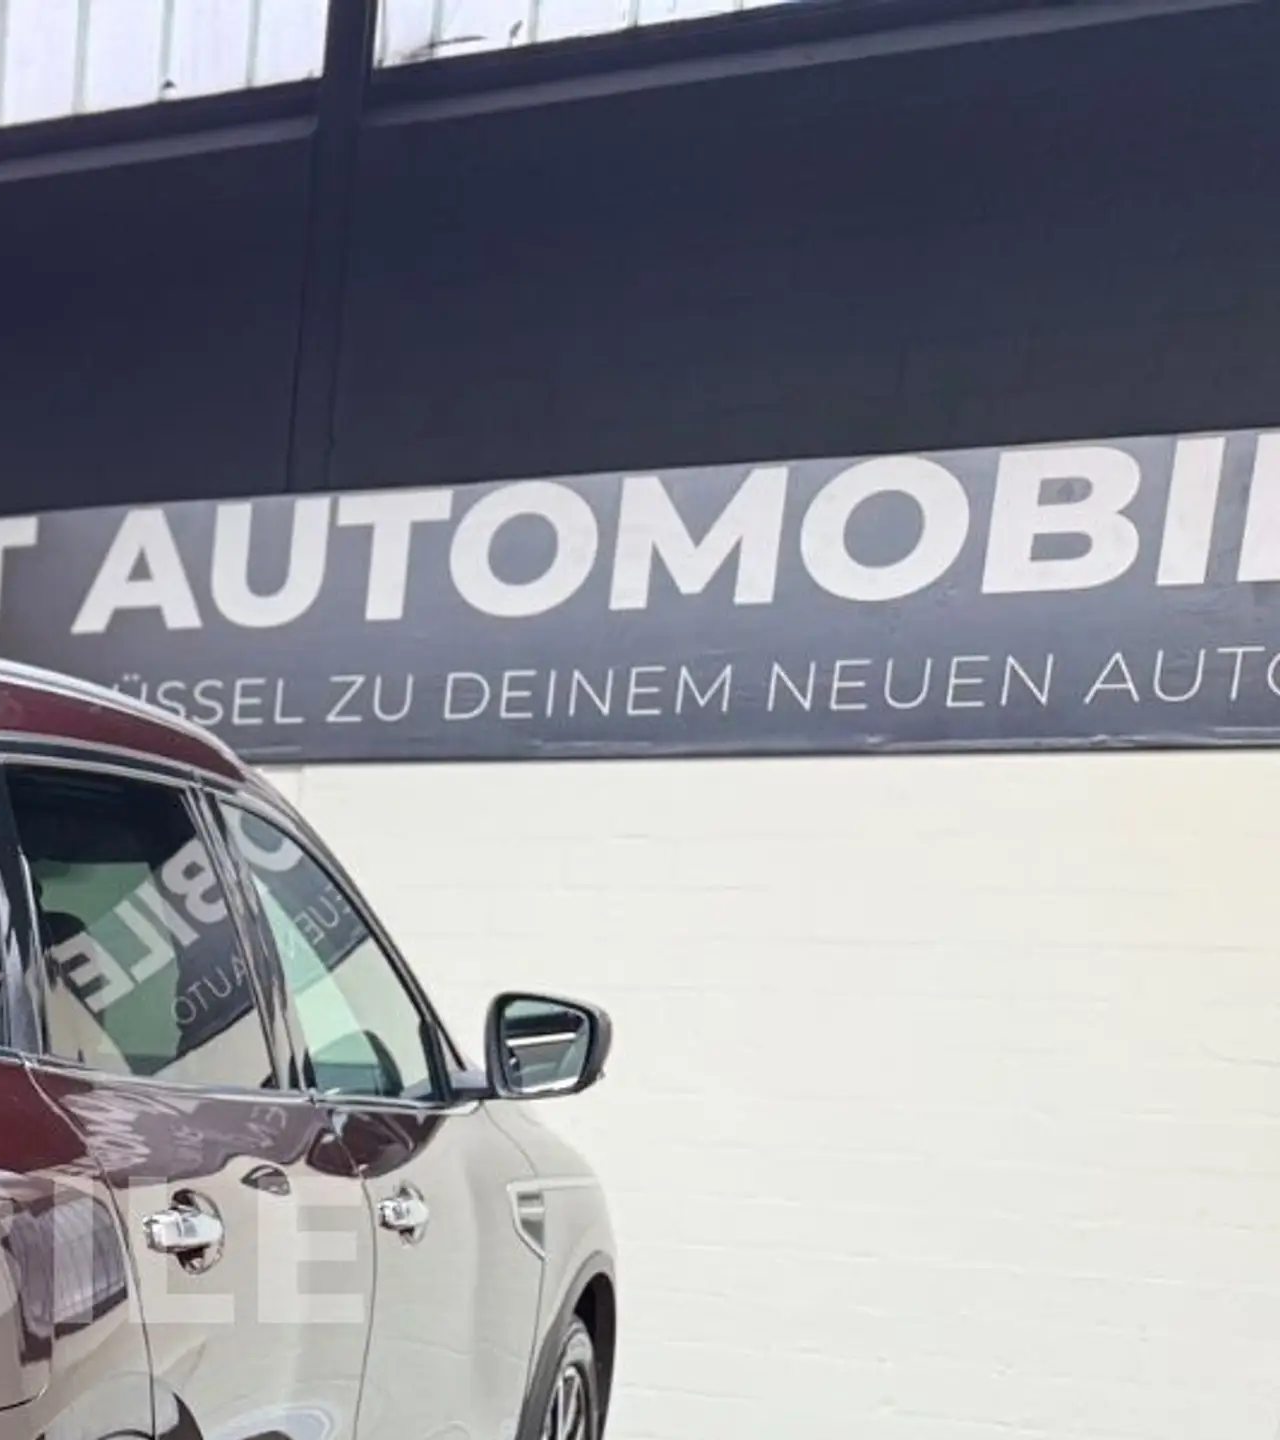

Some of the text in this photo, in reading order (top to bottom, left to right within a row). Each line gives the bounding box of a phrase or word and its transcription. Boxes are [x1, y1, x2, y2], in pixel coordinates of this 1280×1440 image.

[71, 433, 1280, 635] AUTOMOBI
[326, 673, 414, 724] ZU
[443, 664, 734, 721] DEINEM
[766, 653, 1054, 711] NEUEN
